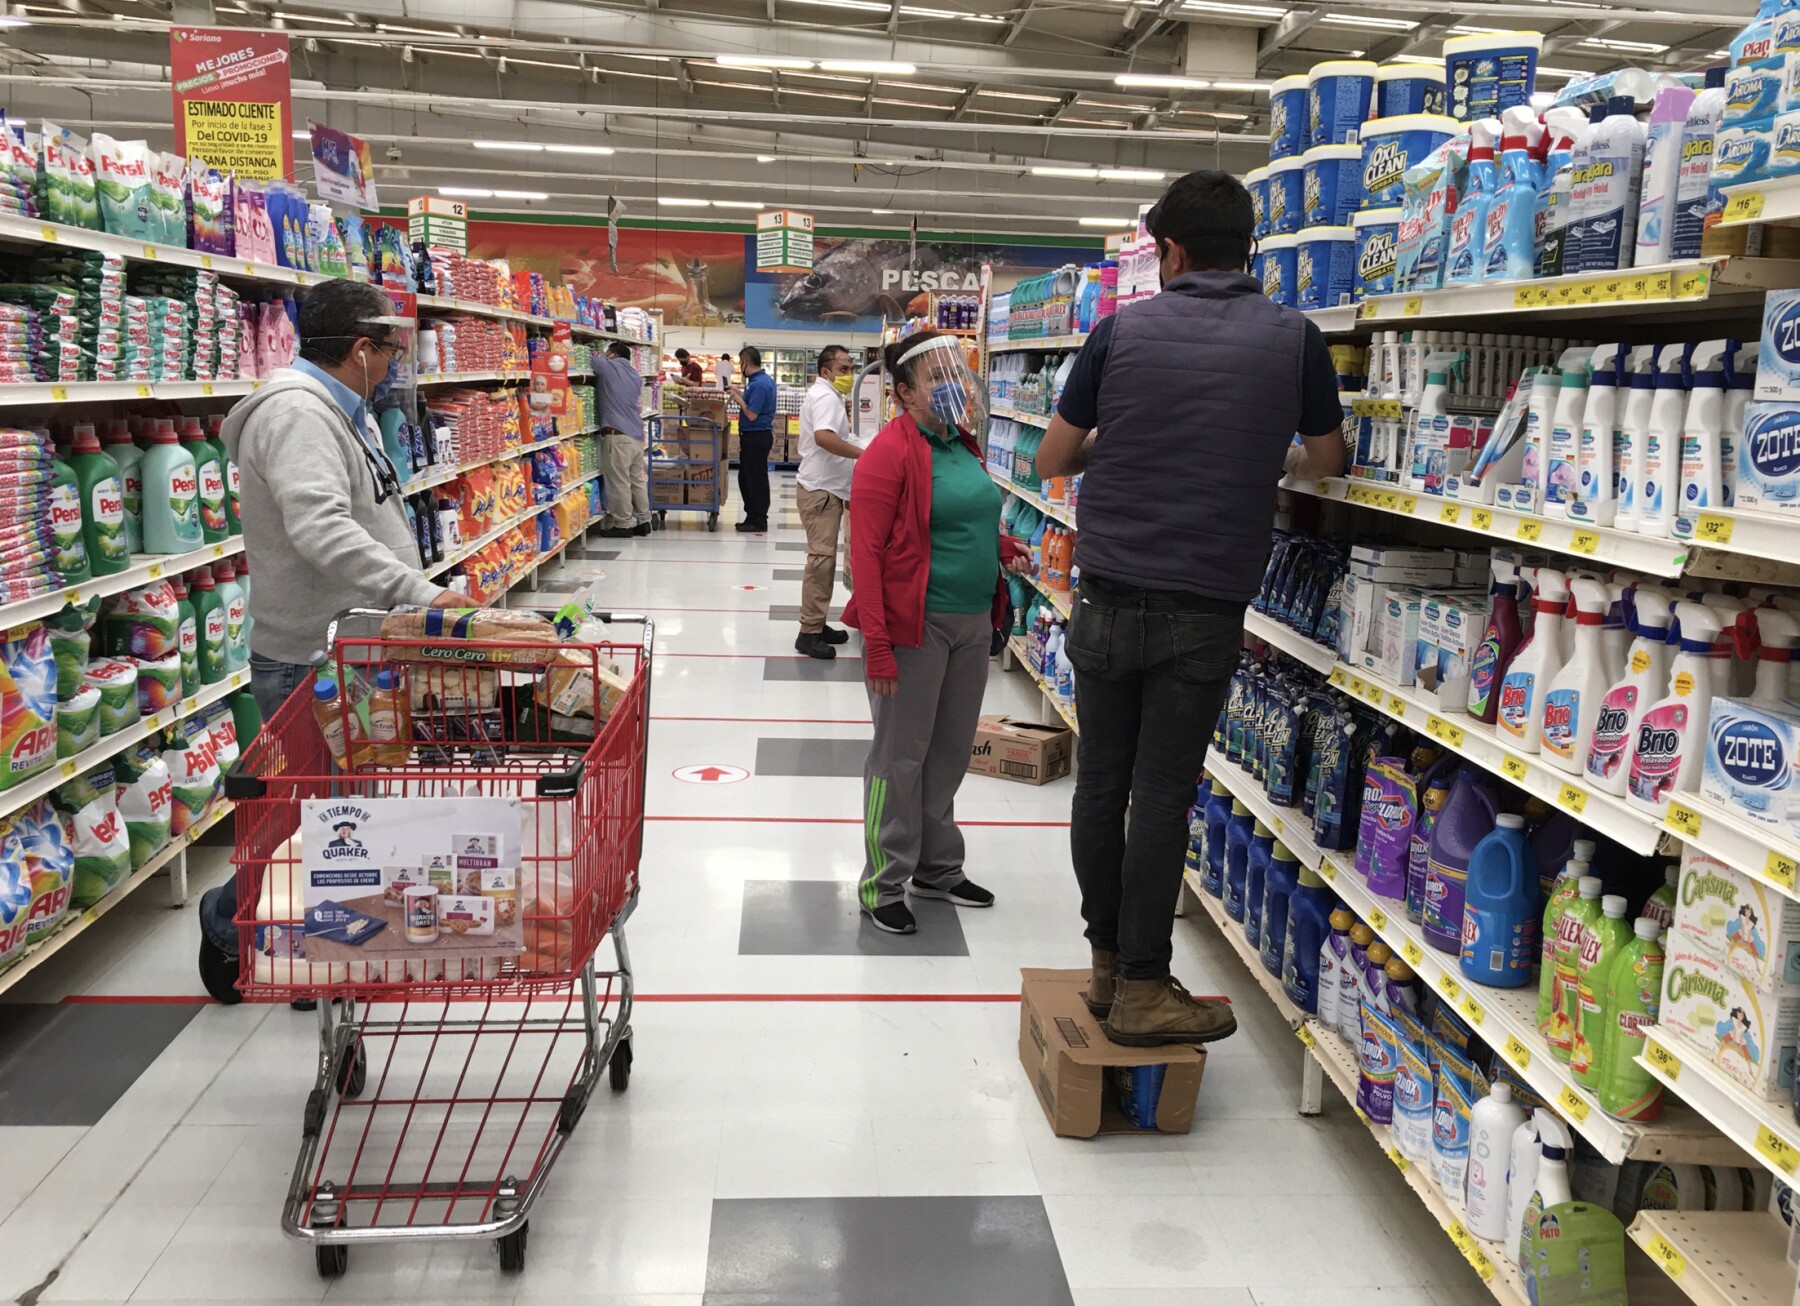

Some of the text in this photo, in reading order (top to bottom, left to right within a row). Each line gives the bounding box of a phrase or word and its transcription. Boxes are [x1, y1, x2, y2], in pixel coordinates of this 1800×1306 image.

[189, 33, 222, 43] Soriana
[195, 47, 255, 73] MEJORES
[176, 52, 284, 91] PRECIOS PROMOCIONES
[188, 101, 275, 119] ESTIMADO CLIENTE
[191, 119, 273, 131] Por inicio de la fase 3
[197, 130, 268, 143] Del COVID-19
[191, 146, 218, 154] Personal
[1373, 142, 1399, 166] OXI
[101, 154, 146, 176] Persil
[203, 155, 228, 167] SANA
[229, 156, 277, 168] DISTANCIA
[1365, 151, 1407, 188] CLEAN
[1690, 162, 1708, 174] Hold
[1370, 173, 1403, 193] VERSATI
[1593, 182, 1609, 194] Hold
[452, 203, 463, 215] 12
[774, 213, 783, 225] 13
[802, 216, 811, 228] 13
[1366, 233, 1392, 251] OXI
[1359, 242, 1398, 275] CLEAN
[1364, 264, 1396, 283] VERSATI
[1782, 319, 1800, 352] ZO
[1757, 427, 1800, 464] ZOTE
[421, 646, 486, 661] Cero Cero
[1501, 684, 1527, 707] Brio
[1544, 703, 1571, 728] Brio
[1596, 705, 1629, 733] Brio
[12, 727, 57, 759] ARIE
[1638, 724, 1679, 755] Brio
[1640, 756, 1673, 764] Prelavador
[1724, 735, 1776, 771] ZOTE
[1741, 773, 1757, 781] BLANCO
[326, 805, 363, 819] TIEMPO
[1676, 808, 1690, 823] $32
[322, 847, 369, 860] QUAKER
[458, 858, 492, 868] MULTIBRAN
[1777, 860, 1791, 876] $20
[1682, 869, 1739, 908] Carisma
[1667, 964, 1730, 1010] Carisma
[1373, 1089, 1393, 1100] POLVO
[1768, 1136, 1784, 1152] $21
[1539, 1226, 1561, 1241] PATO
